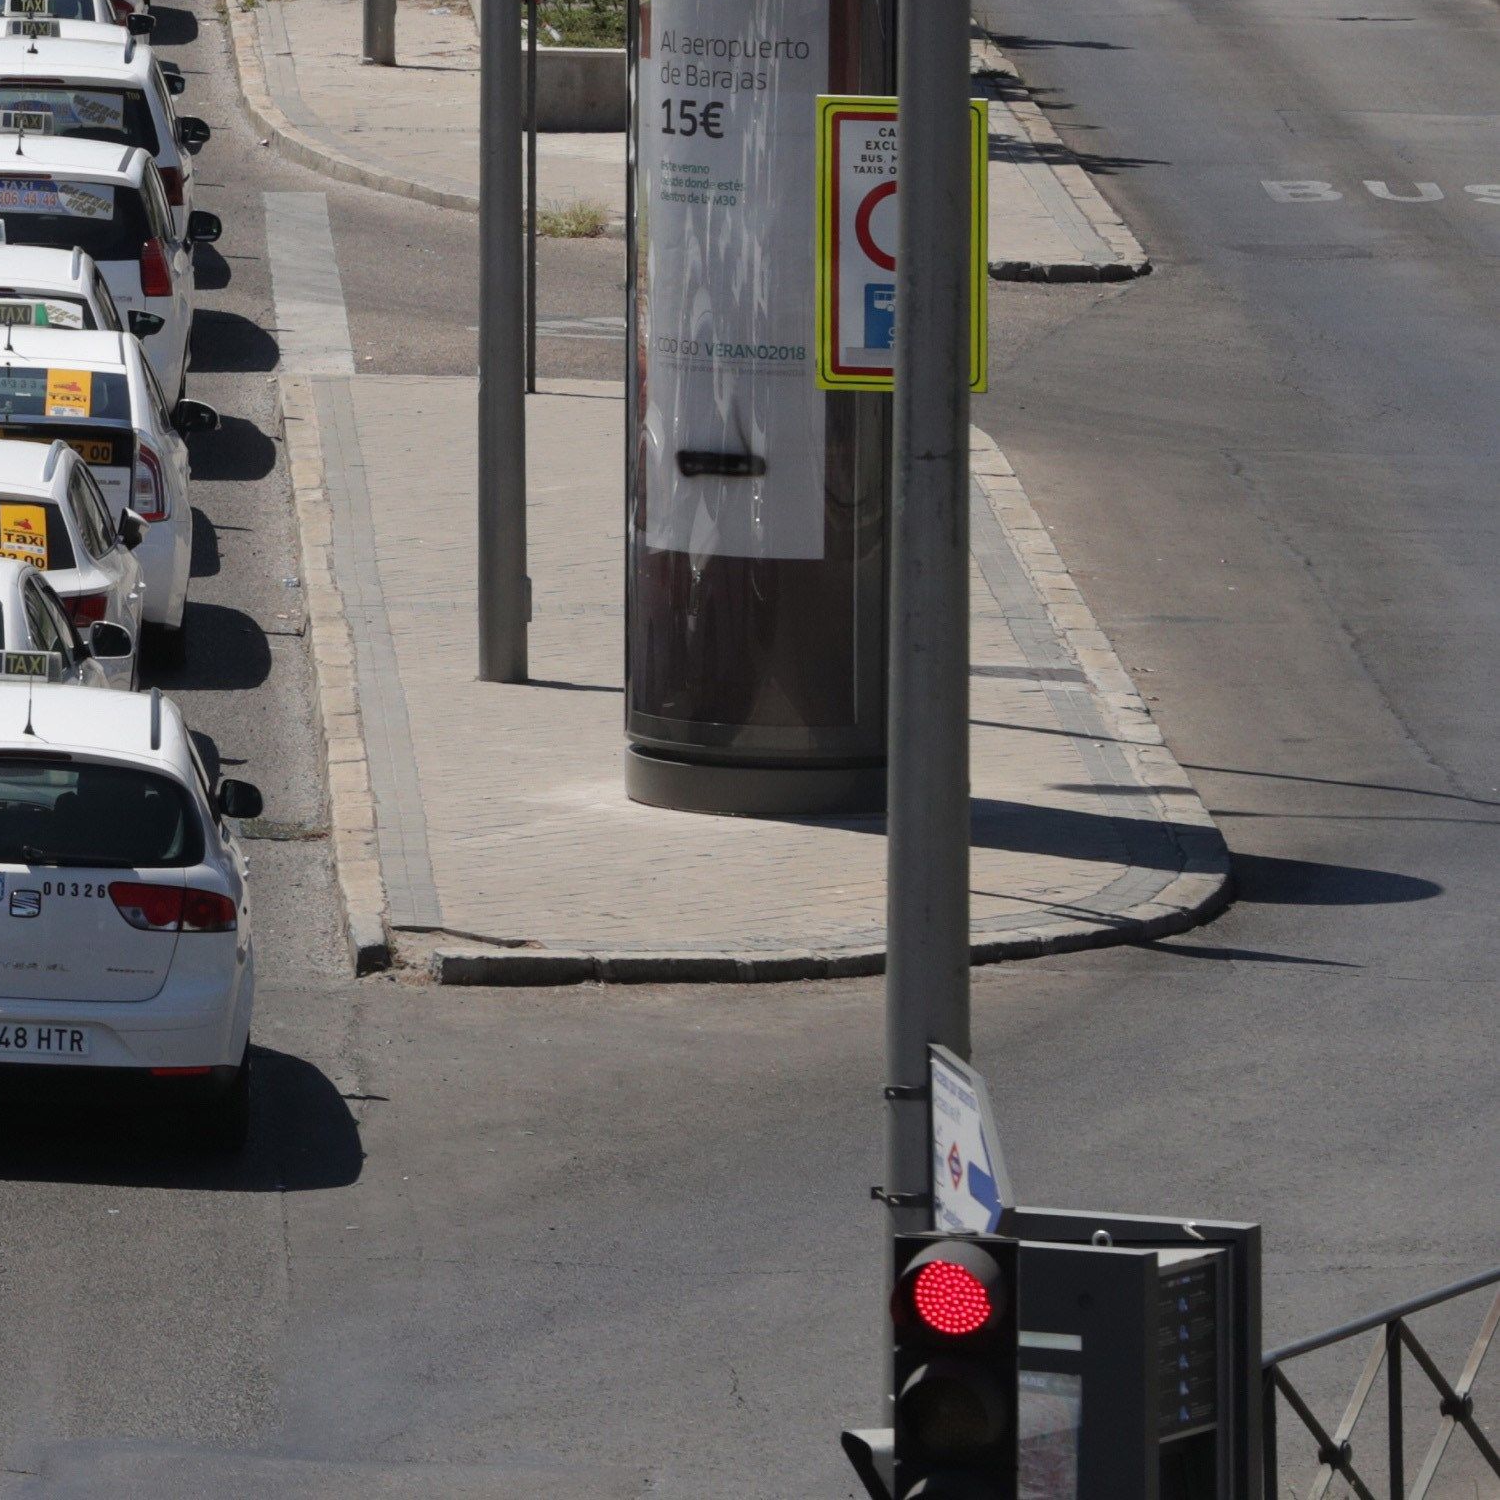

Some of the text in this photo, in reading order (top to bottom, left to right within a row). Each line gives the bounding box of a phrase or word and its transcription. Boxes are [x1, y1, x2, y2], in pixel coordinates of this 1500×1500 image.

[21, 0, 45, 12] TAXI
[660, 29, 810, 62] Al aeropuerto
[660, 63, 768, 94] de Barajas
[15, 114, 42, 128] TAXI
[661, 98, 725, 140] 15€
[865, 140, 896, 151] EXCL
[674, 162, 710, 175] verano
[852, 165, 884, 175] TAXIS
[713, 194, 737, 207] M30
[1, 306, 30, 322] TAXI
[705, 341, 806, 361] VERANO2018
[5, 532, 45, 547] Taxi
[7, 654, 46, 674] TAXI
[43, 881, 106, 899] 00326
[37, 1028, 84, 1052] HTR
